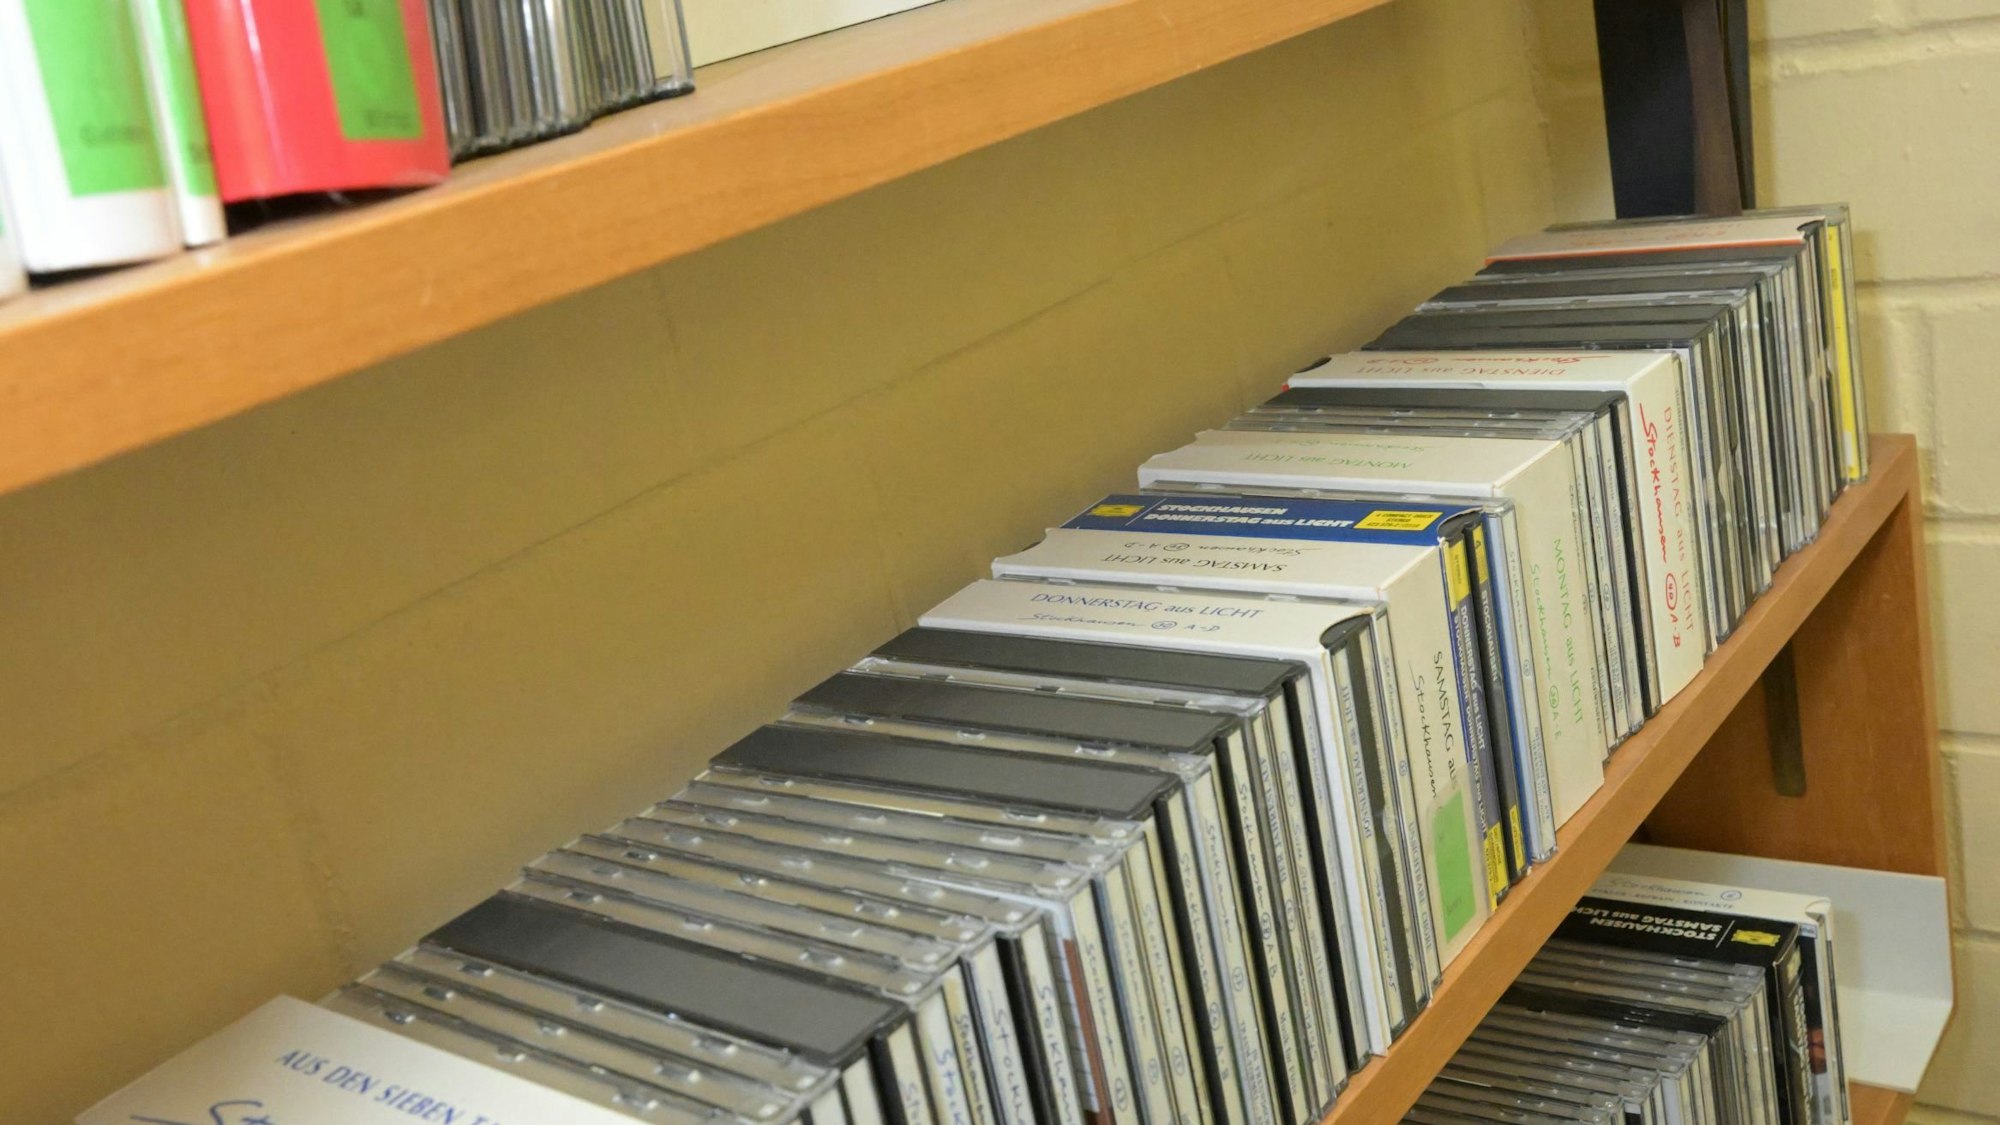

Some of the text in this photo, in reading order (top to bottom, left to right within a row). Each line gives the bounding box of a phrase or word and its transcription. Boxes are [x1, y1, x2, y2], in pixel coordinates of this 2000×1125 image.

[1355, 366, 1414, 375] LICHT
[1462, 367, 1566, 376] DIENSTAG
[1244, 453, 1412, 470] MONTAG aus LICHT
[1639, 403, 1667, 564] Stockhausen
[1144, 512, 1355, 529] DONNERSTAG aus LICHT
[1156, 503, 1288, 516] STOCKHAUSEN
[1664, 407, 1683, 518] DIENSTAG
[1676, 529, 1686, 562] aus
[1681, 570, 1694, 632] LICHT
[1099, 553, 1288, 573] SAMSTAG aus LICHT
[1017, 611, 1147, 628] Stockhausen
[1030, 592, 1264, 619] DONNERSTAG aus LICHT
[1481, 589, 1499, 682] STOCKHAUSEN
[1530, 563, 1551, 681] Stockhausen
[1553, 538, 1583, 724] MONTAG aus LICHT
[1433, 650, 1455, 753] SAMSTAG
[1460, 605, 1478, 692] DONNERSTAG
[1475, 706, 1486, 750] LICHT
[1407, 660, 1437, 799] Stockhausen
[1258, 755, 1283, 849] JAHRESLAUF
[1353, 751, 1373, 839] DONNERSTAG
[1233, 772, 1264, 909] Stockhausen
[1179, 852, 1210, 994] Stockhausen
[1590, 917, 1717, 942] STOCKHAUSEN
[1611, 910, 1640, 921] aus
[1641, 914, 1723, 932] SAMSTAG
[275, 1050, 468, 1125] AUS DEN SIEBEN
